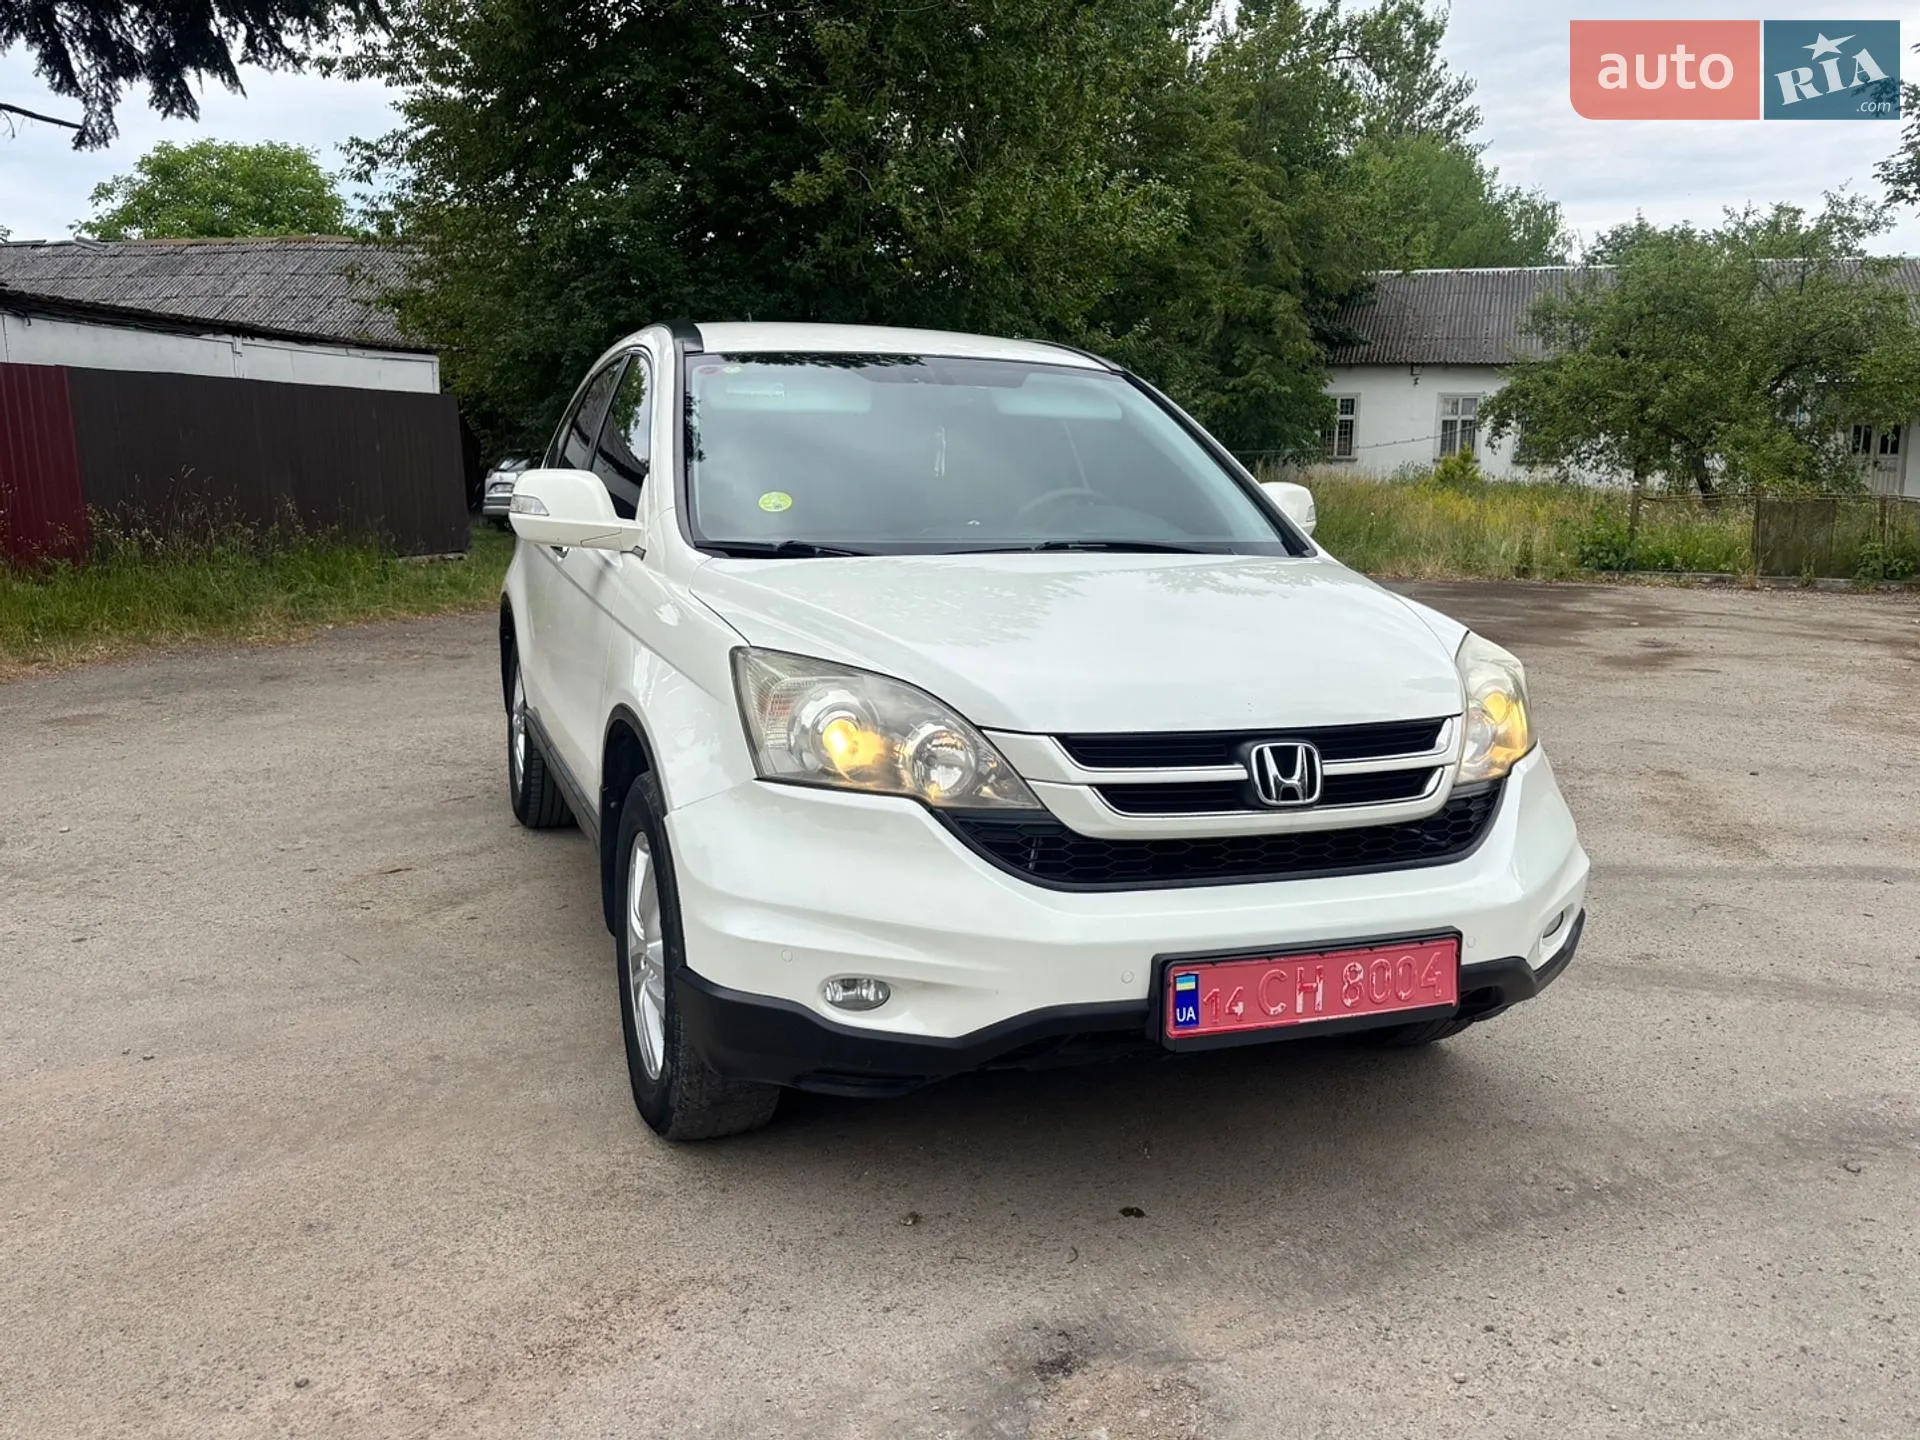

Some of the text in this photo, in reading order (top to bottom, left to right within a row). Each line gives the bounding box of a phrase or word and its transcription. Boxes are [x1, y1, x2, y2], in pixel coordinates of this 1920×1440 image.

[1202, 952, 1442, 1024] 14 CH 8004
[1176, 1007, 1197, 1022] UA
